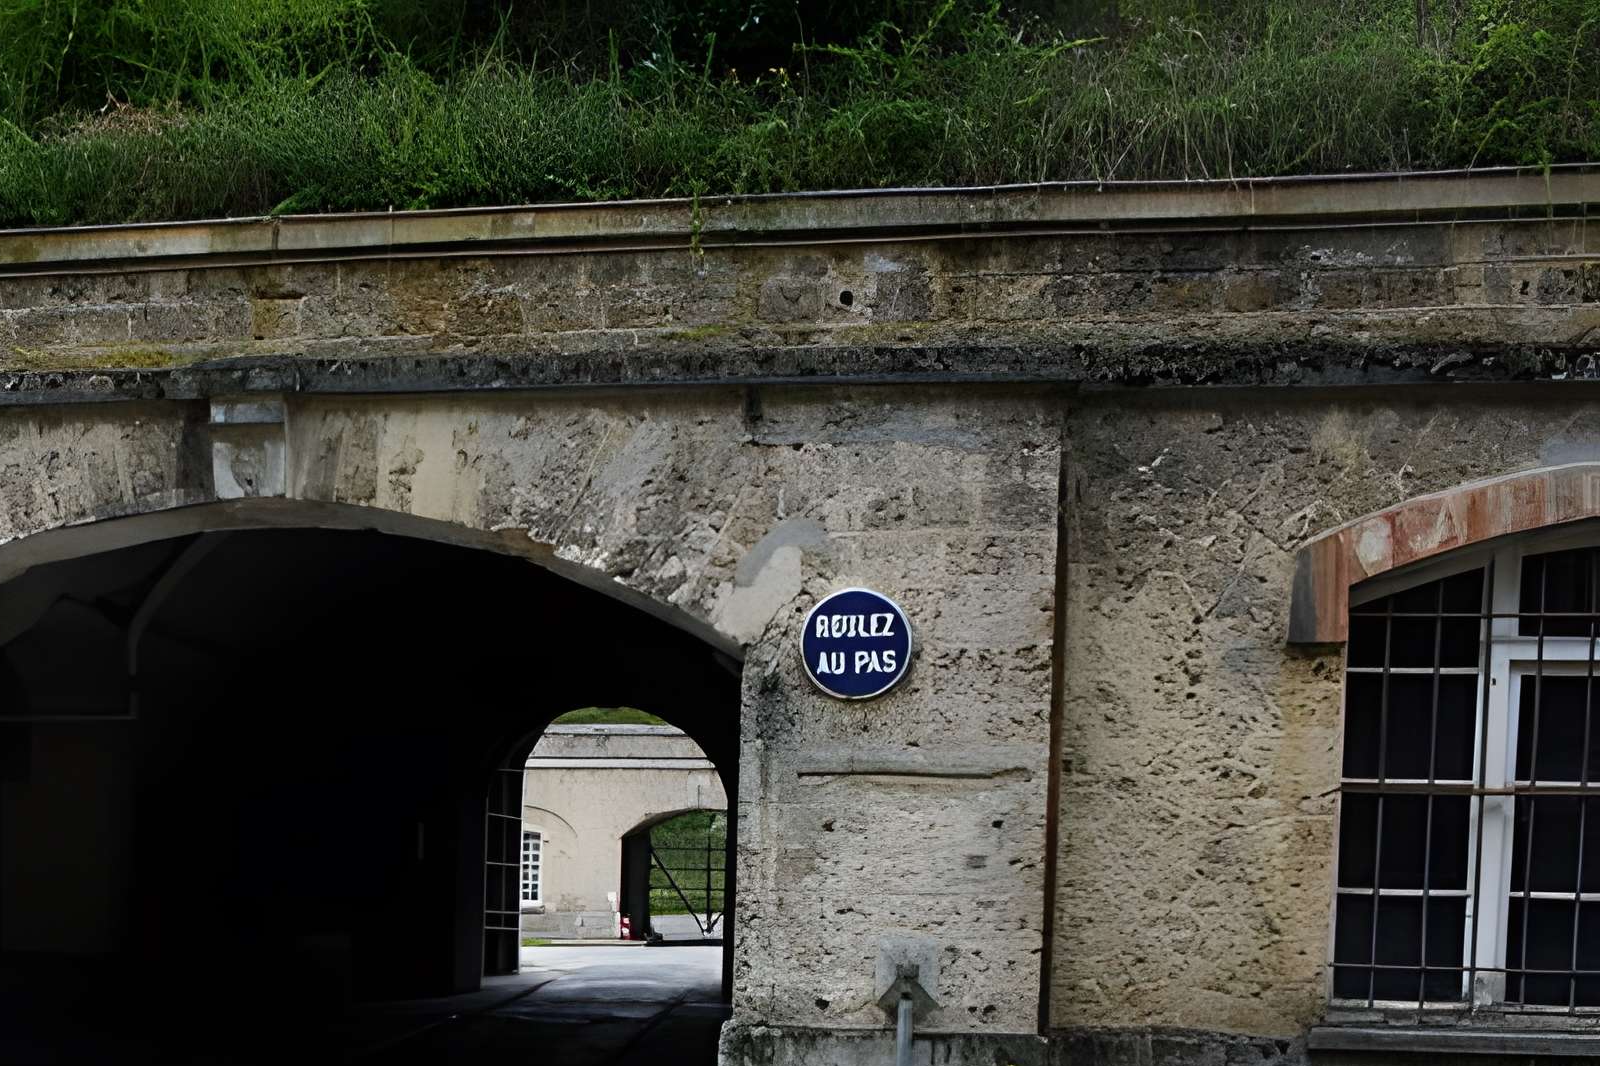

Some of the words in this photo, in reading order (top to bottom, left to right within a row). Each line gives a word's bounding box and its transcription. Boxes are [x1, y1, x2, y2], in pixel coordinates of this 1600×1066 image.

[816, 613, 895, 638] ROULEZ
[817, 651, 845, 675] AU
[854, 650, 897, 675] PAS
